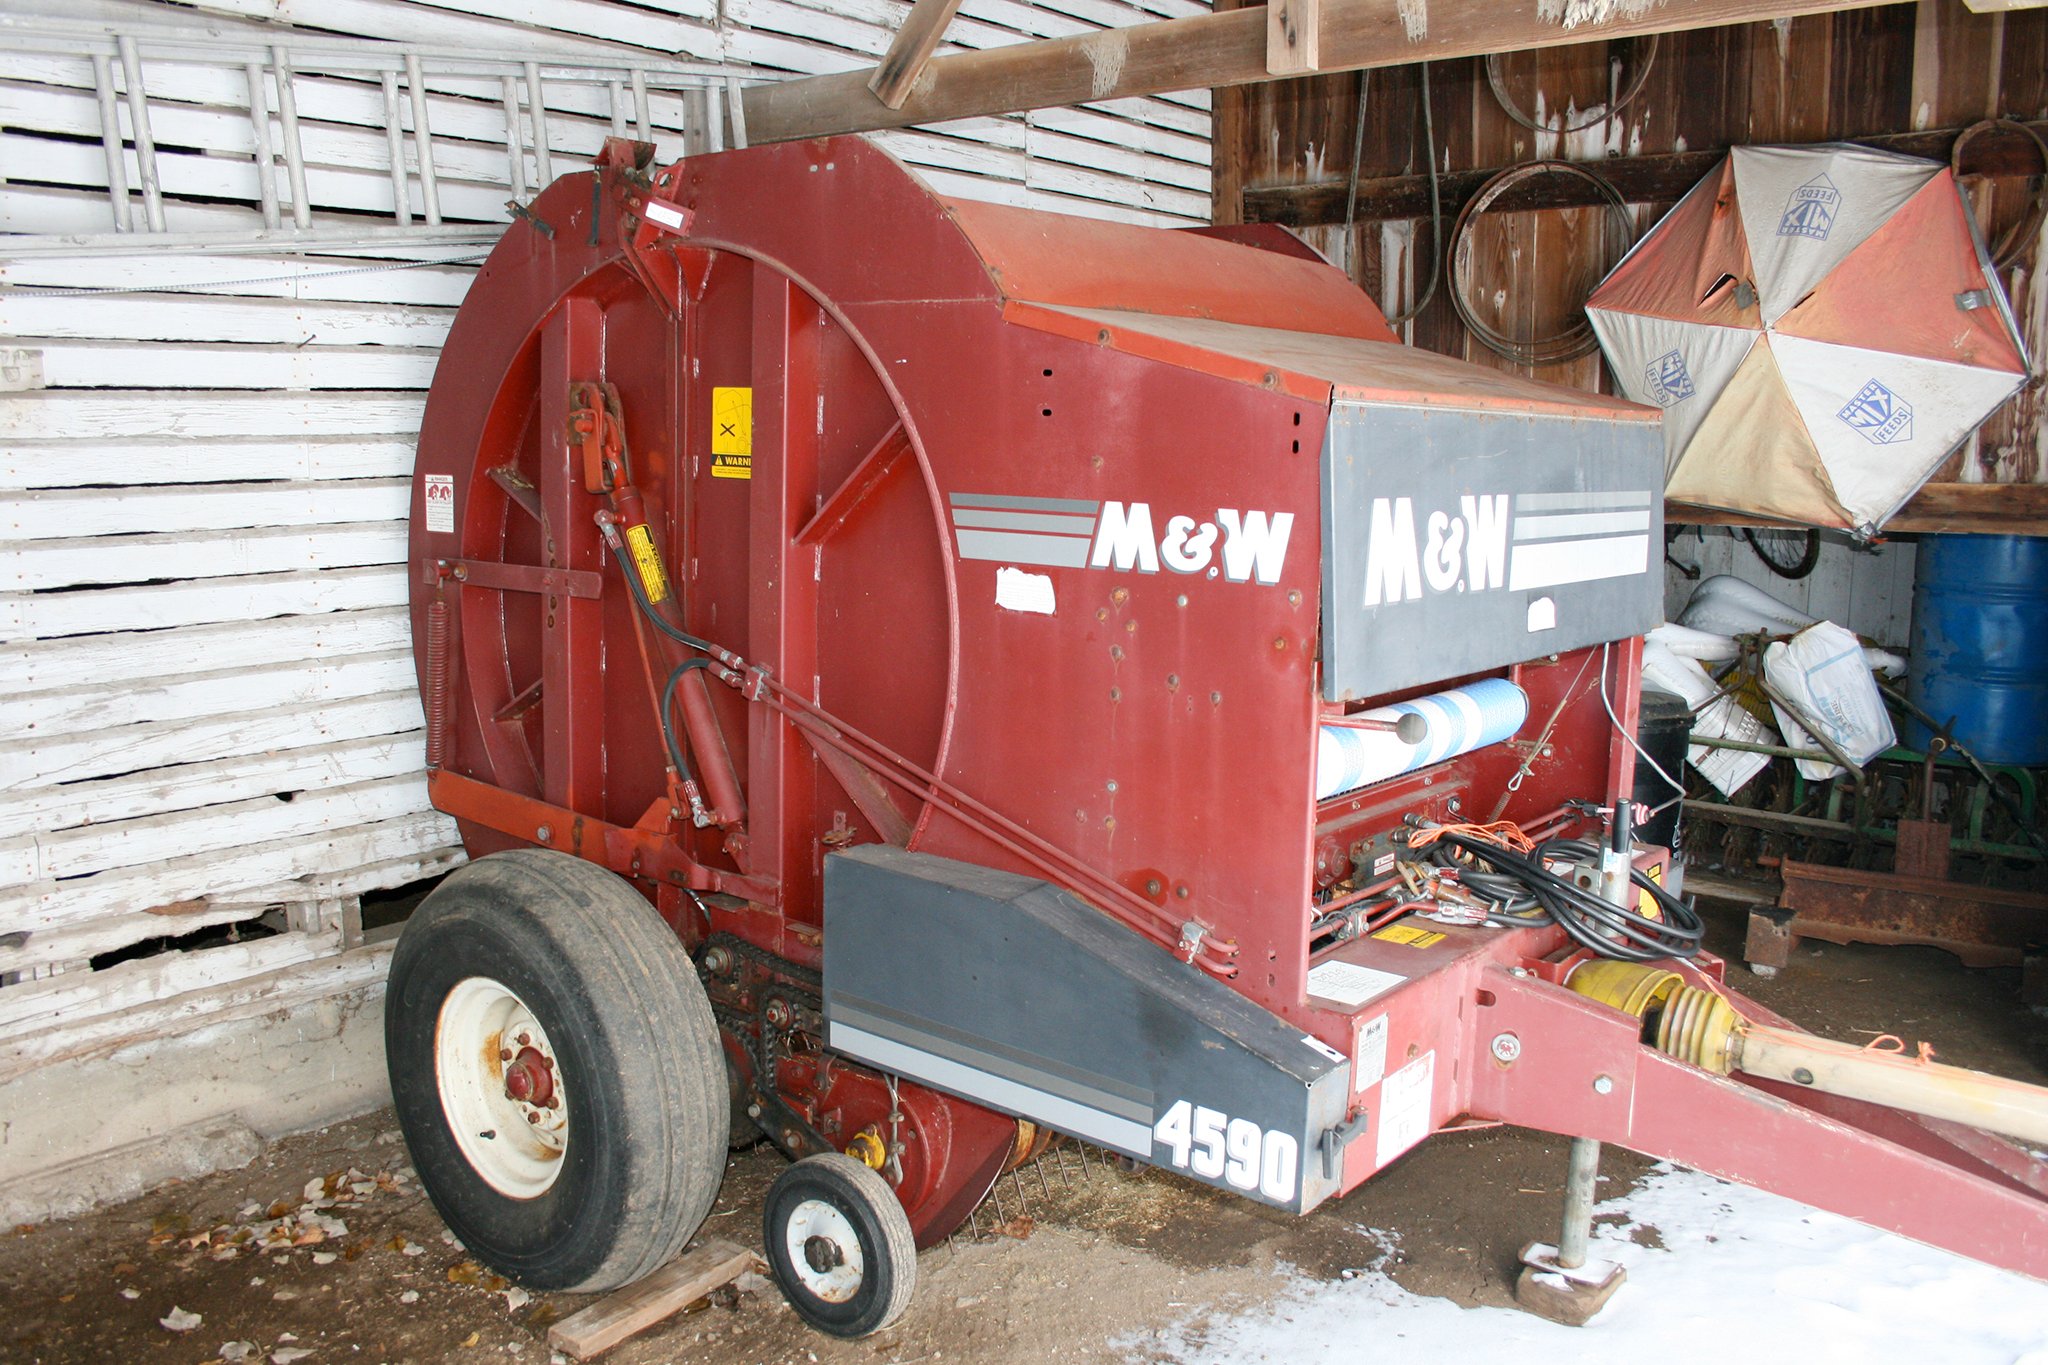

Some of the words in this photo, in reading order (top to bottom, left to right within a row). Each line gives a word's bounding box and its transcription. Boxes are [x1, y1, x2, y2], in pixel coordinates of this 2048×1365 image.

[1800, 189, 1833, 200] FEEDS
[1785, 203, 1828, 230] MIX
[1782, 226, 1825, 237] MASTER
[1649, 372, 1666, 400] FEEDS
[1842, 383, 1877, 419] MASTER
[1848, 389, 1888, 427] MIX
[1878, 411, 1908, 439] FEEDS
[1153, 1099, 1298, 1204] 4590
